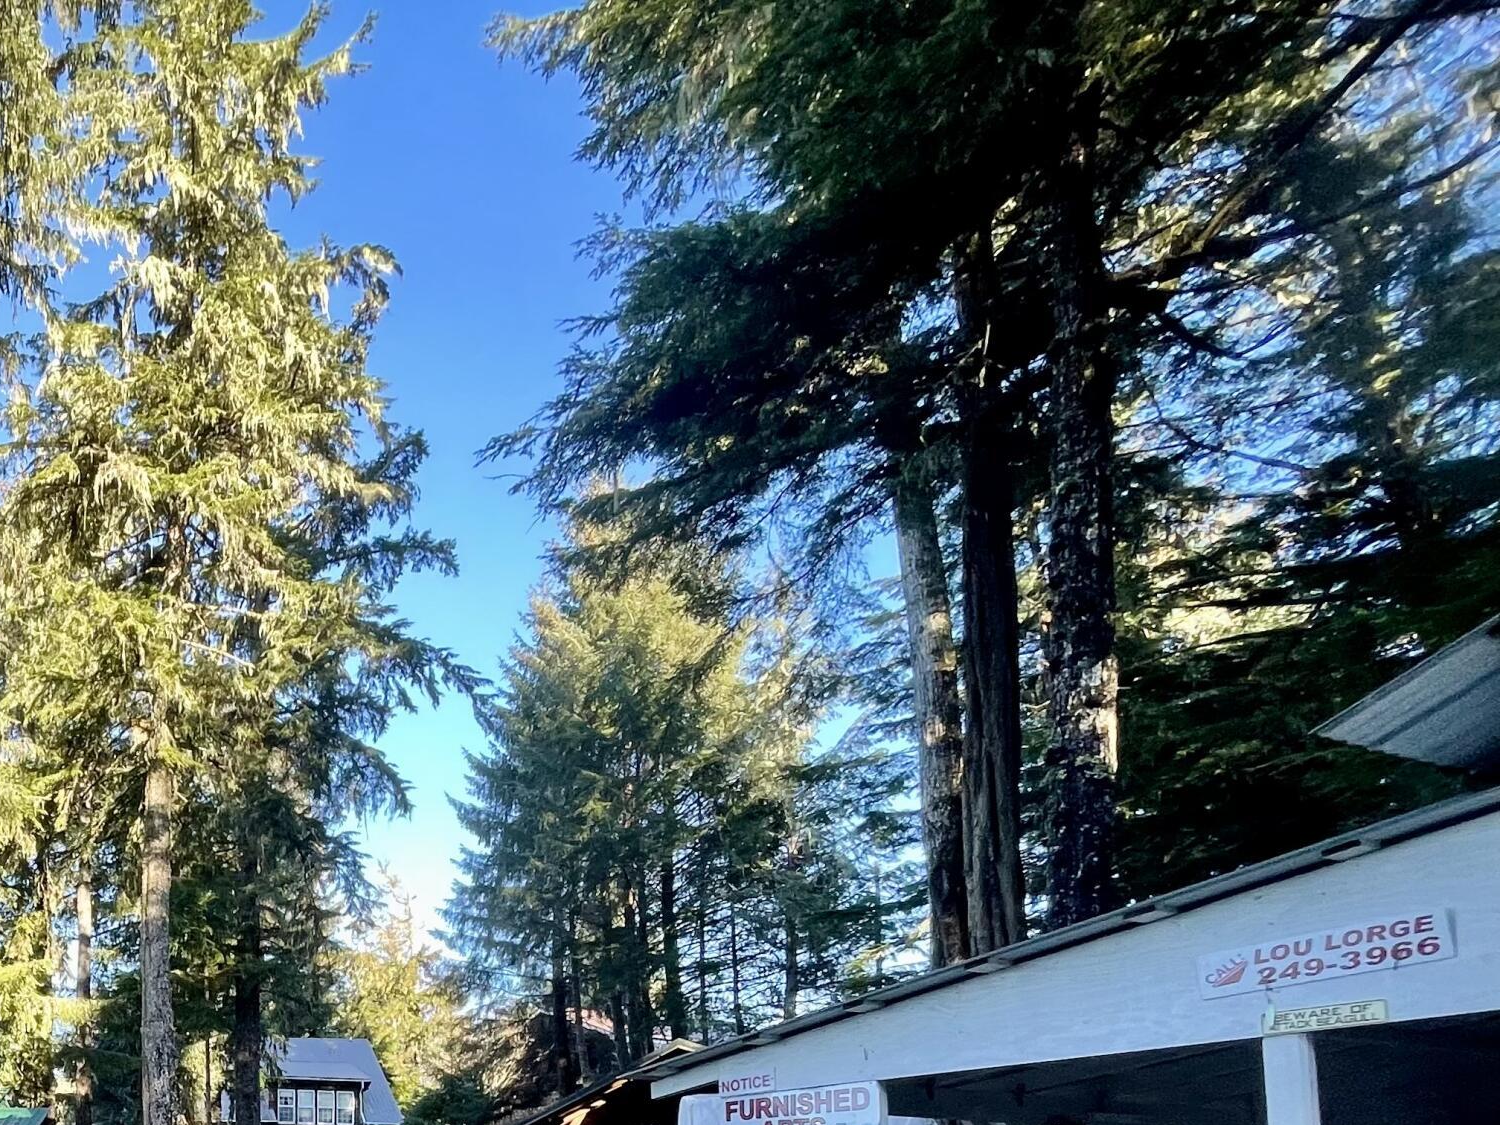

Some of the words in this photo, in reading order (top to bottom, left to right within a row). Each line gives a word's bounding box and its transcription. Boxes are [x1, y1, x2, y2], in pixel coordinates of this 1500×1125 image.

[1253, 938, 1312, 965] LOU
[1324, 914, 1434, 951] LORGE
[1256, 936, 1441, 986] 249-3966
[1274, 1006, 1342, 1023] BEWARE
[1350, 1003, 1373, 1014] OF
[1316, 1012, 1380, 1027] SEAGULL
[721, 1074, 771, 1093] NOTICE
[725, 1087, 871, 1122] FURNISHED
